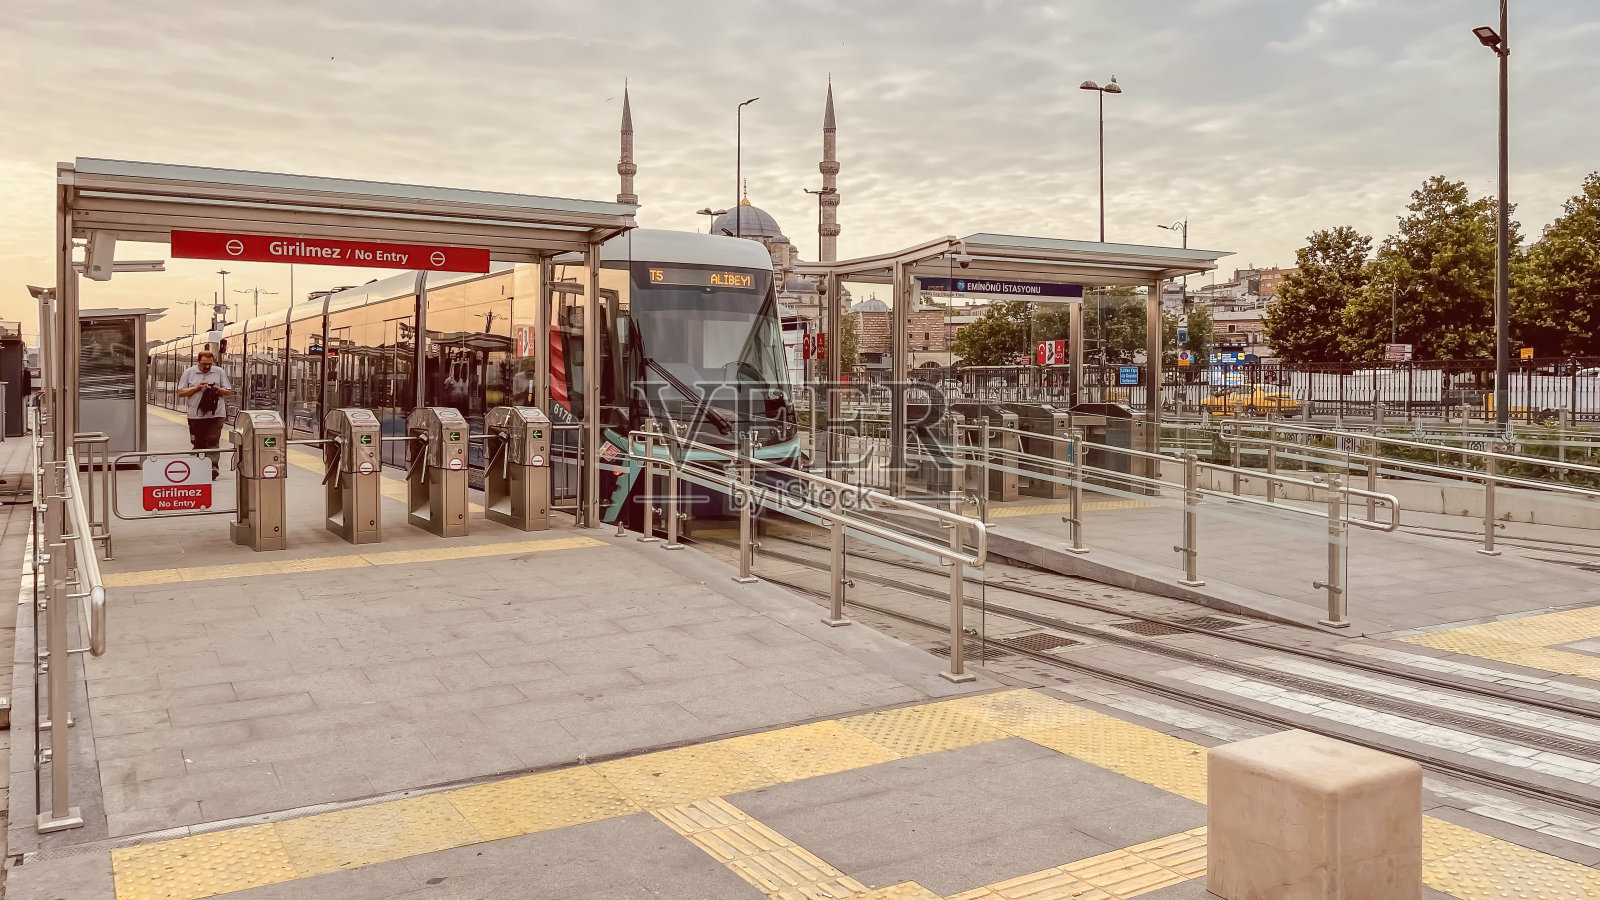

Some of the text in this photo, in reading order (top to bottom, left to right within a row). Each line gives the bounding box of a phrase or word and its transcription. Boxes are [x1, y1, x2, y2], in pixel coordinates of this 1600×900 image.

[269, 241, 409, 265] Girilmez / No Entry
[649, 269, 664, 281] T5
[967, 281, 1001, 293] EMİNÖNÜ
[1002, 283, 1041, 294] İSTASYONU
[152, 487, 202, 498] Girilmez
[158, 499, 196, 508] No Entry
